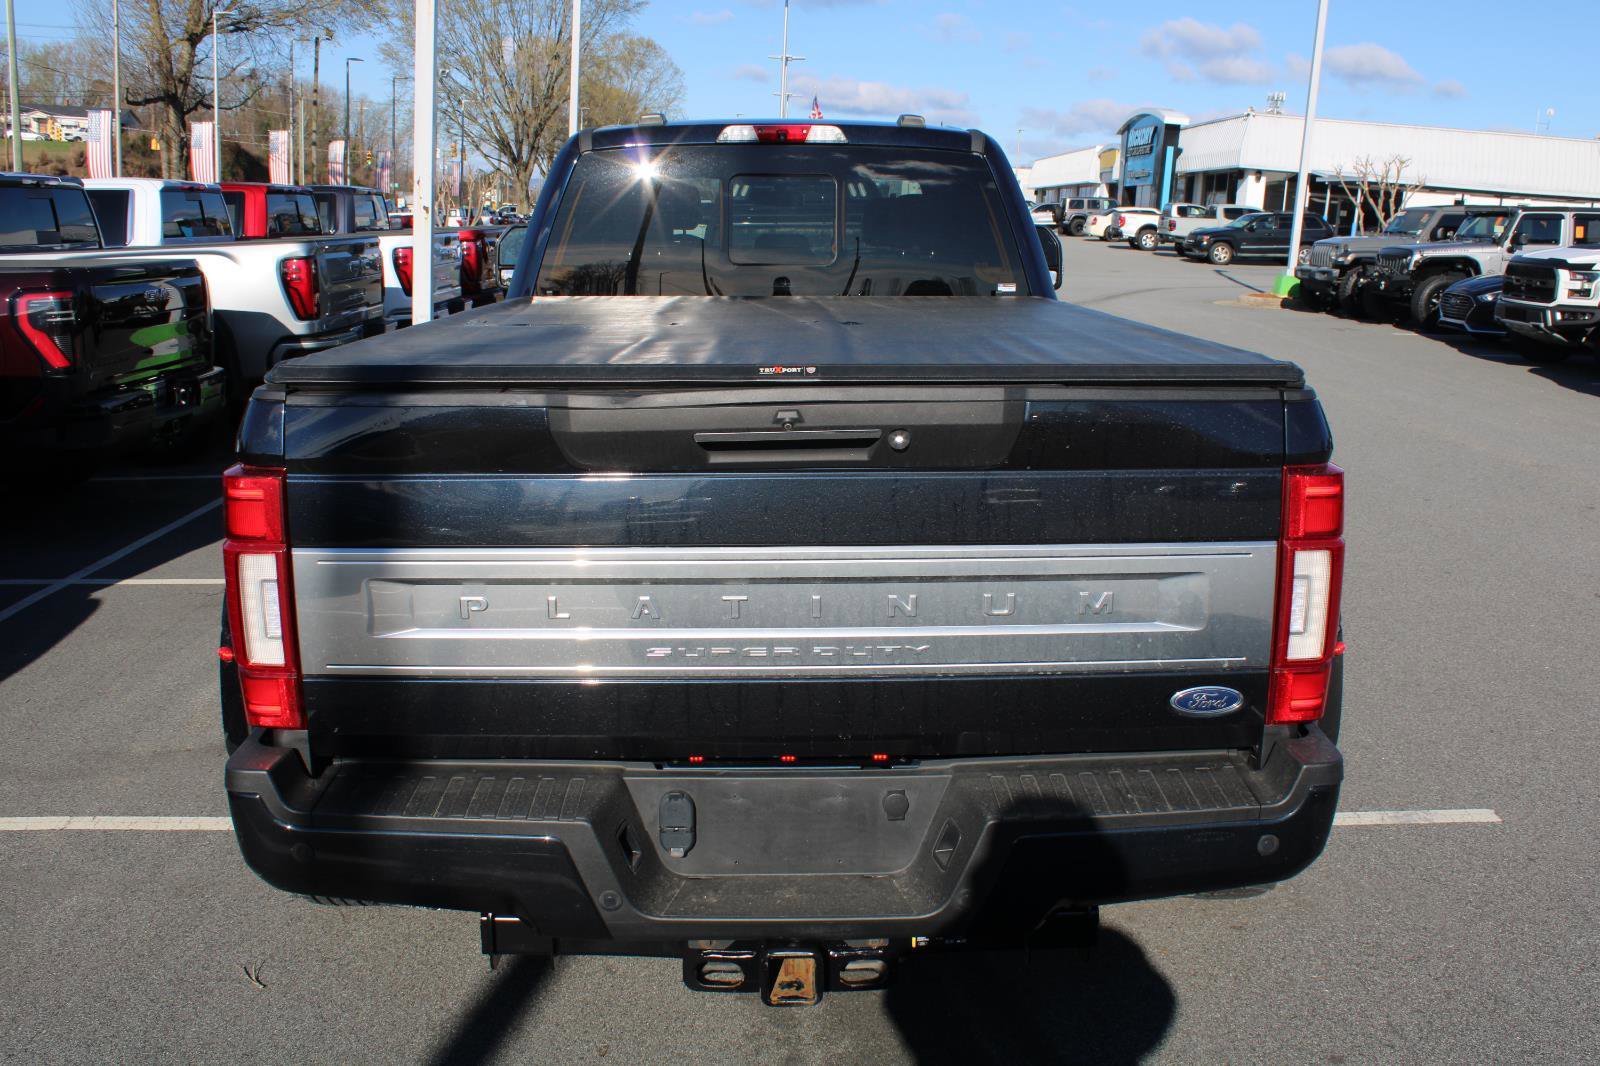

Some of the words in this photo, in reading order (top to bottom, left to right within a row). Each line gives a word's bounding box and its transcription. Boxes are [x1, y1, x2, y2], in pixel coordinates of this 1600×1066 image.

[759, 365, 802, 374] TRUXPORT
[459, 591, 1114, 620] PLATINUM
[645, 646, 800, 658] SUPER
[812, 645, 931, 657] DUTY
[1187, 692, 1229, 710] Ford
